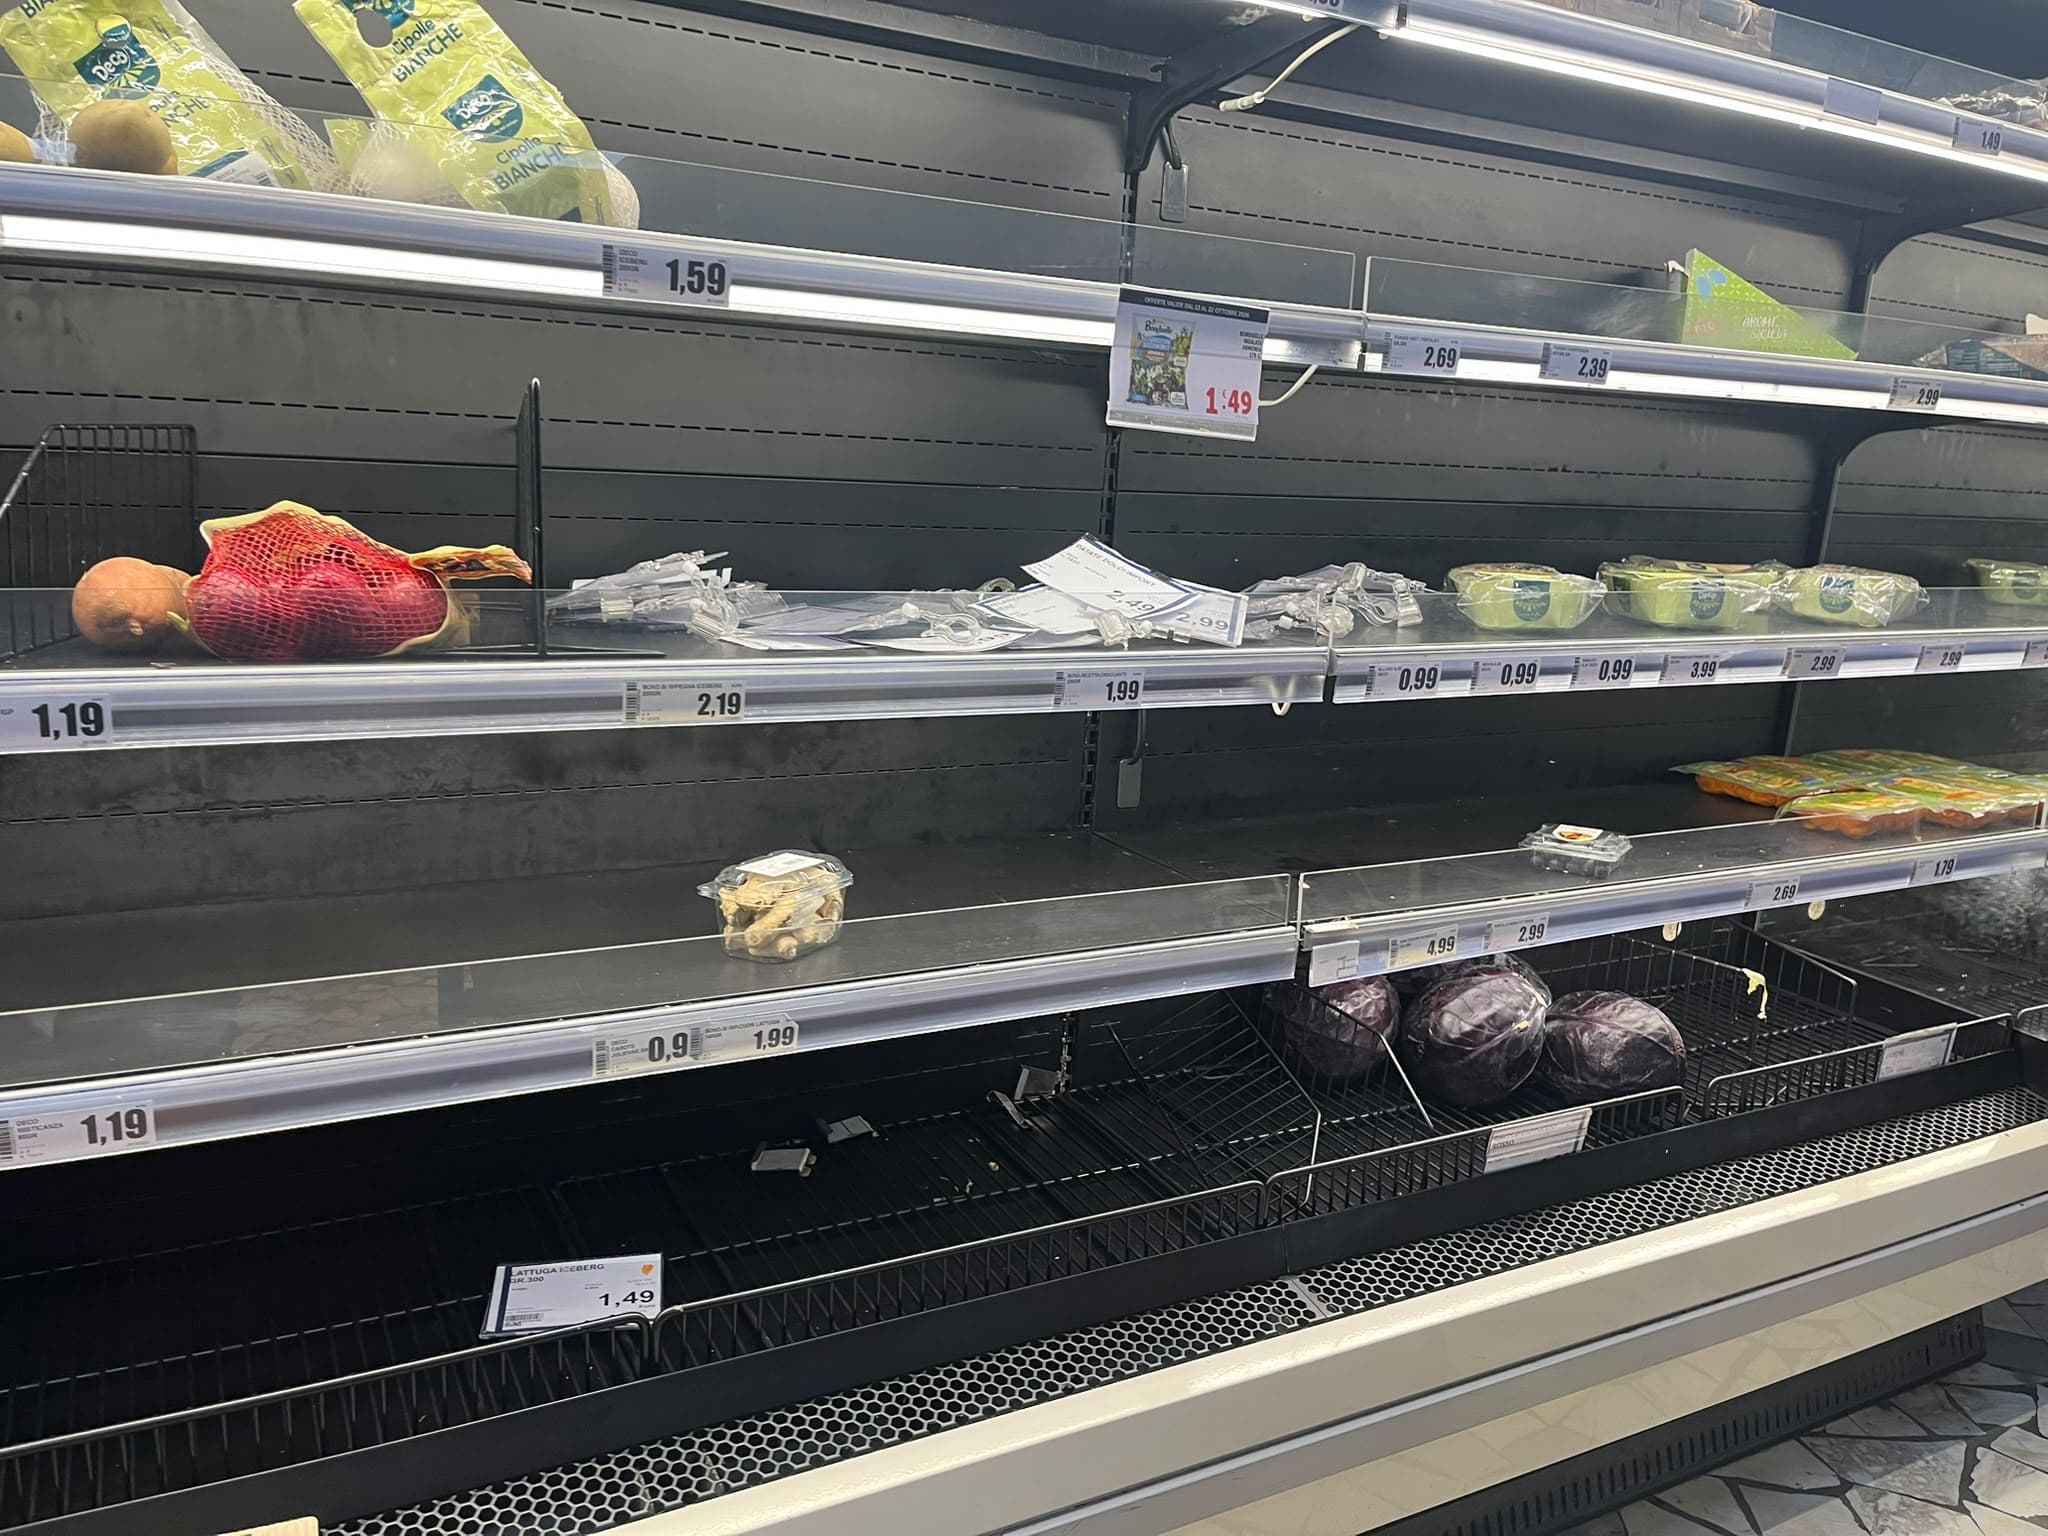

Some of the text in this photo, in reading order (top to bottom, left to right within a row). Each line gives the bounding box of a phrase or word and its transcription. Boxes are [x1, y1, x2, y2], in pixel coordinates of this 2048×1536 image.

[392, 17, 436, 56] Cipolle
[391, 22, 464, 83] BIANCHE
[495, 135, 541, 165] Cipolle
[493, 142, 571, 191] BIANCHE
[666, 259, 726, 296] 1,59
[1424, 346, 1457, 369] 2,69
[1577, 357, 1608, 379] 2,39
[1917, 388, 1940, 406] 2,99
[1075, 543, 1102, 560] PATATE
[1102, 557, 1126, 575] DOLCI
[1125, 569, 1157, 588] IMPORT
[1105, 590, 1155, 613] 2,49
[1599, 659, 1633, 682] 0,99
[1690, 661, 1717, 679] 3,99
[1811, 655, 1835, 671] 2,99
[1940, 652, 1962, 667] 2,99
[1399, 667, 1439, 692] 0,99
[1500, 662, 1537, 687] 0,99
[1105, 680, 1140, 702] 1,99
[697, 692, 741, 717] 2,19
[32, 702, 104, 741] 1,19
[1934, 857, 1955, 878] 1,79
[1773, 884, 1797, 901] 2,69
[1518, 923, 1545, 943] 2,99
[1426, 936, 1456, 956] 4,99
[753, 1026, 795, 1050] 1,99
[80, 1108, 147, 1146] 1,19
[510, 1263, 605, 1277] LATTUGA ICEBERG
[599, 1290, 655, 1308] 1,49
